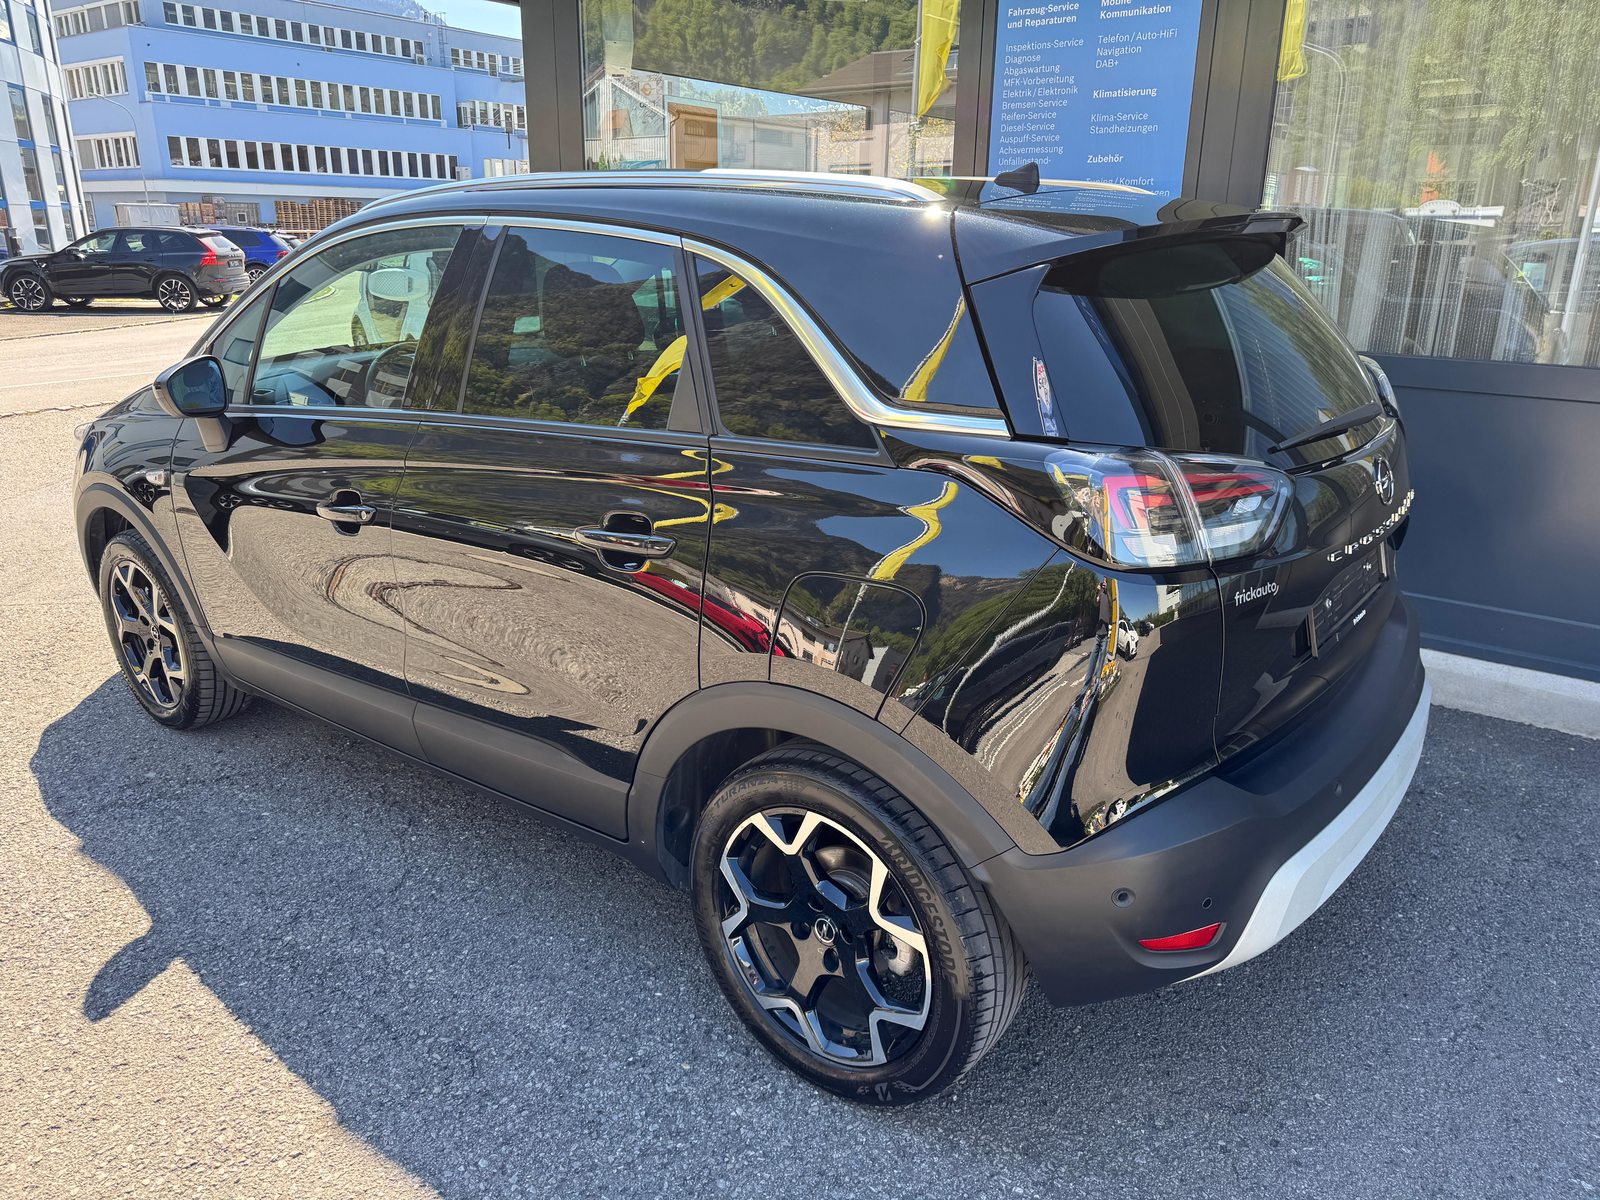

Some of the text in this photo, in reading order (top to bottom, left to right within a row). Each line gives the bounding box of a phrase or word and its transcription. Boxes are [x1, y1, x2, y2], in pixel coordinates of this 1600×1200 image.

[1007, 2, 1080, 17] Fahrzeug-Service
[1100, 4, 1172, 20] Kommunikation
[1007, 15, 1077, 29] und Reparaturen
[1098, 32, 1130, 44] Telefon
[1135, 28, 1178, 41] Auto-HiFi
[1005, 38, 1084, 53] Inspektions-Service
[1096, 45, 1142, 58] Navigation
[1005, 54, 1041, 65] Diagnose
[1095, 59, 1119, 69] DAB+
[1004, 64, 1061, 77] Abgaswartung
[1003, 75, 1075, 87] MFK-Vorbereitung
[1093, 87, 1158, 99] Klimatisierung
[1002, 99, 1068, 110] Bremsen-Service
[1001, 111, 1057, 121] Reifen-Service
[1091, 111, 1149, 122] Klima-Service
[1000, 122, 1056, 133] Diesel-Service
[1090, 123, 1159, 134] Standheizungen
[1000, 134, 1061, 145] Auspuff-Service
[999, 145, 1064, 156] Achsvermessung
[1087, 154, 1124, 164] Zubehör
[1119, 177, 1154, 187] Komfort
[1234, 581, 1279, 607] frickauto
